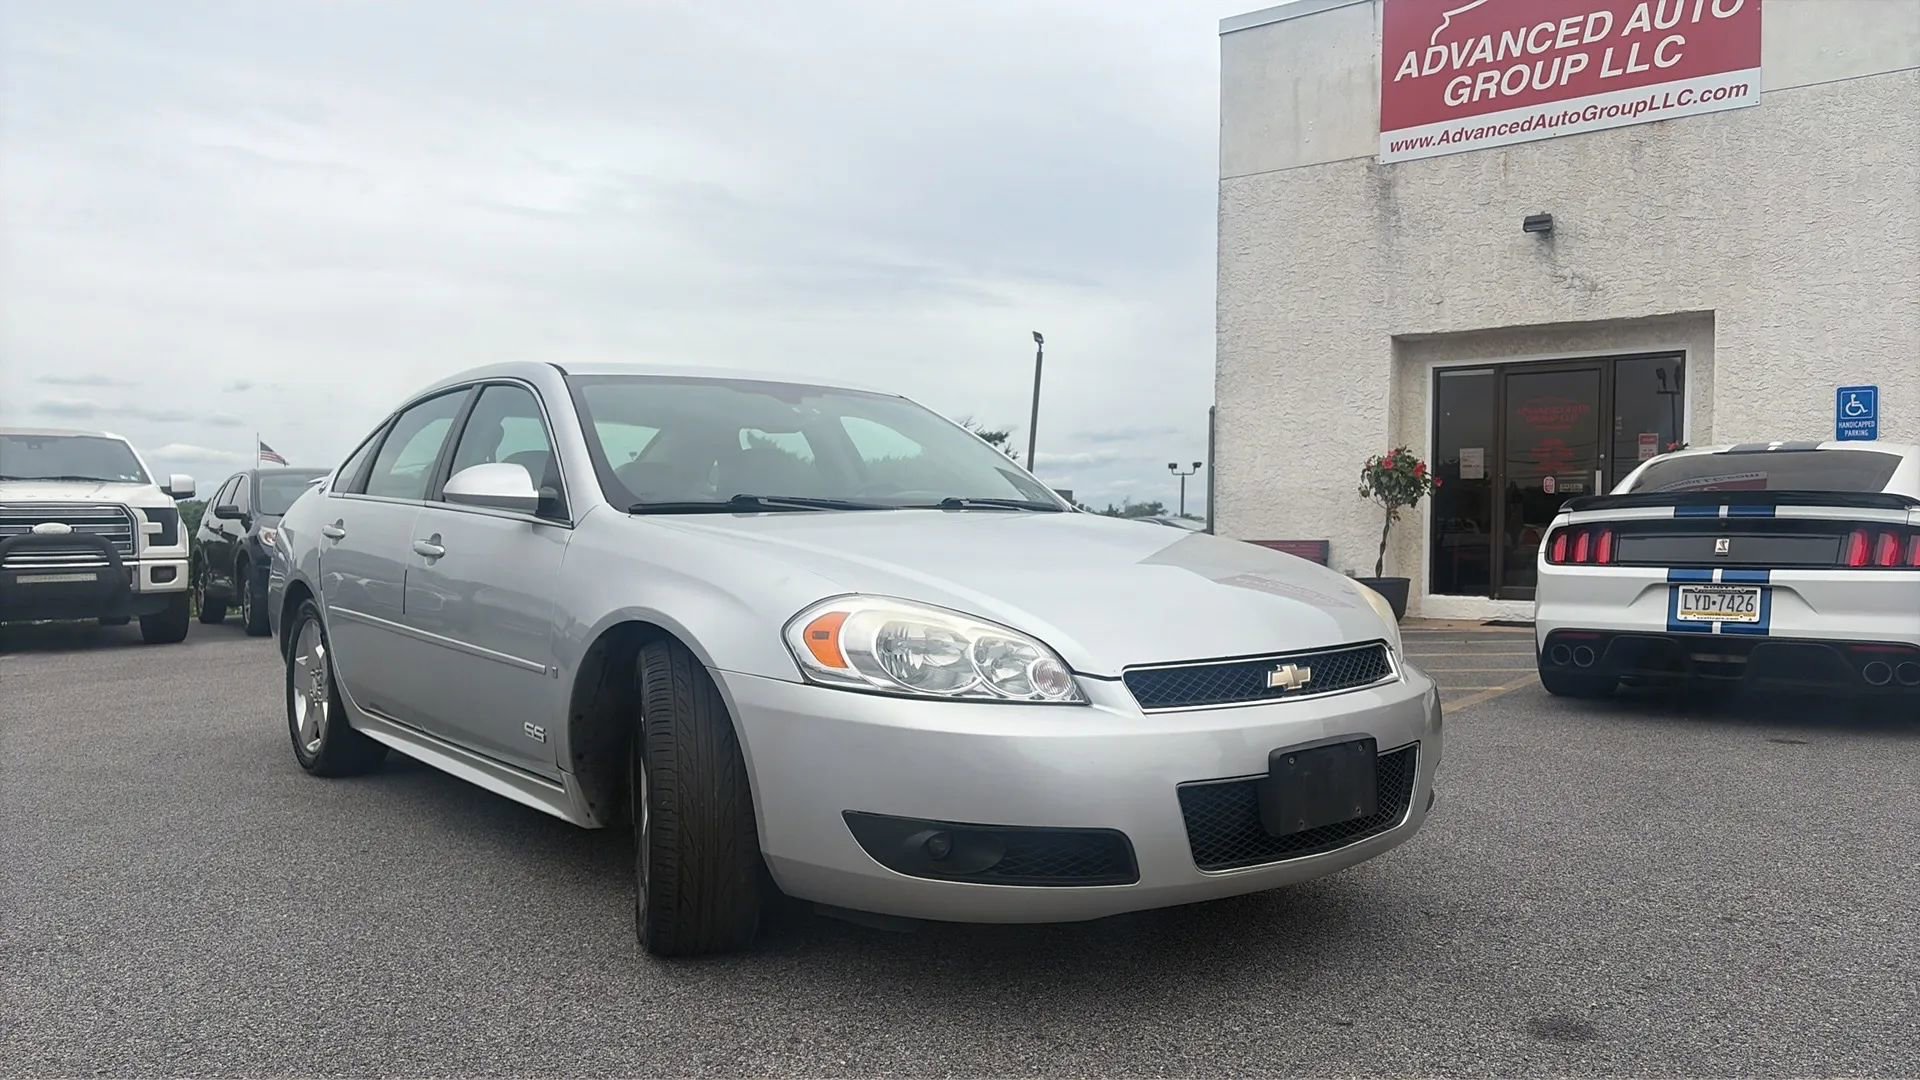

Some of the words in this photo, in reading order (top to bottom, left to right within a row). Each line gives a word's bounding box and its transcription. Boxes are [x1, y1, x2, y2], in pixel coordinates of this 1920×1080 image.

[1394, 10, 1614, 82] ADVANCED
[1621, 0, 1744, 37] AUTO
[1443, 52, 1589, 107] GROUP
[1600, 34, 1686, 79] LLC
[1390, 83, 1749, 153] www.AdvancedAutoGroupLLC.com
[1838, 421, 1876, 429] HANDICAPPED
[1844, 429, 1869, 437] PARKING
[524, 721, 545, 743] SS
